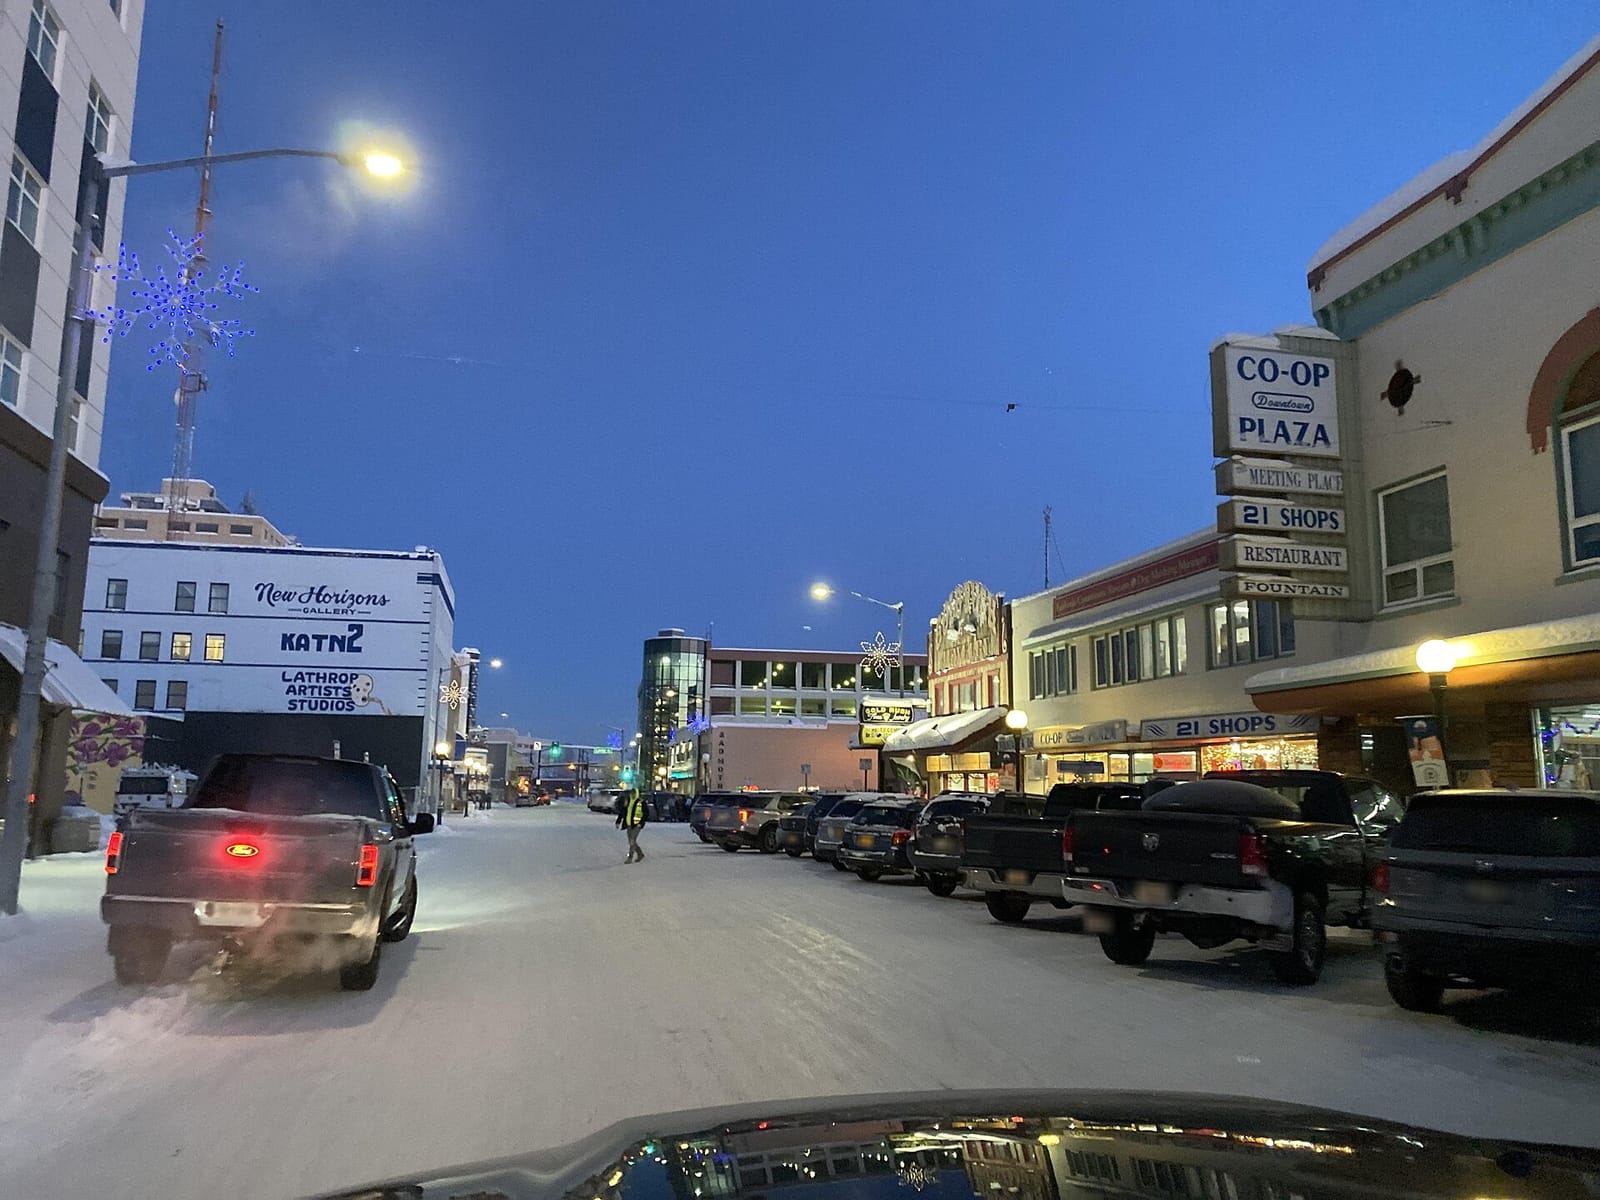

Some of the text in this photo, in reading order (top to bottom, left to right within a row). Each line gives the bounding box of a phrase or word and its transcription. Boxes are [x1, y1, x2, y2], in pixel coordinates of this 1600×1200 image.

[1237, 356, 1330, 387] CO-OP
[1256, 395, 1311, 410] Downtown
[1239, 417, 1331, 448] PLAZA
[1249, 469, 1344, 491] MEETING PLACE
[1243, 505, 1339, 530] 21 SHOPS
[1244, 546, 1342, 566] RESTAURANT
[254, 583, 390, 608] New Horizons
[1244, 582, 1343, 596] FOUNTAIN
[303, 607, 357, 615] GALLERY
[282, 671, 359, 684] LATHROP
[285, 685, 353, 696] ARTISTS
[288, 700, 355, 711] STUDIOS
[1176, 715, 1276, 736] 21 SHOPS
[1040, 731, 1062, 743] CO-OP
